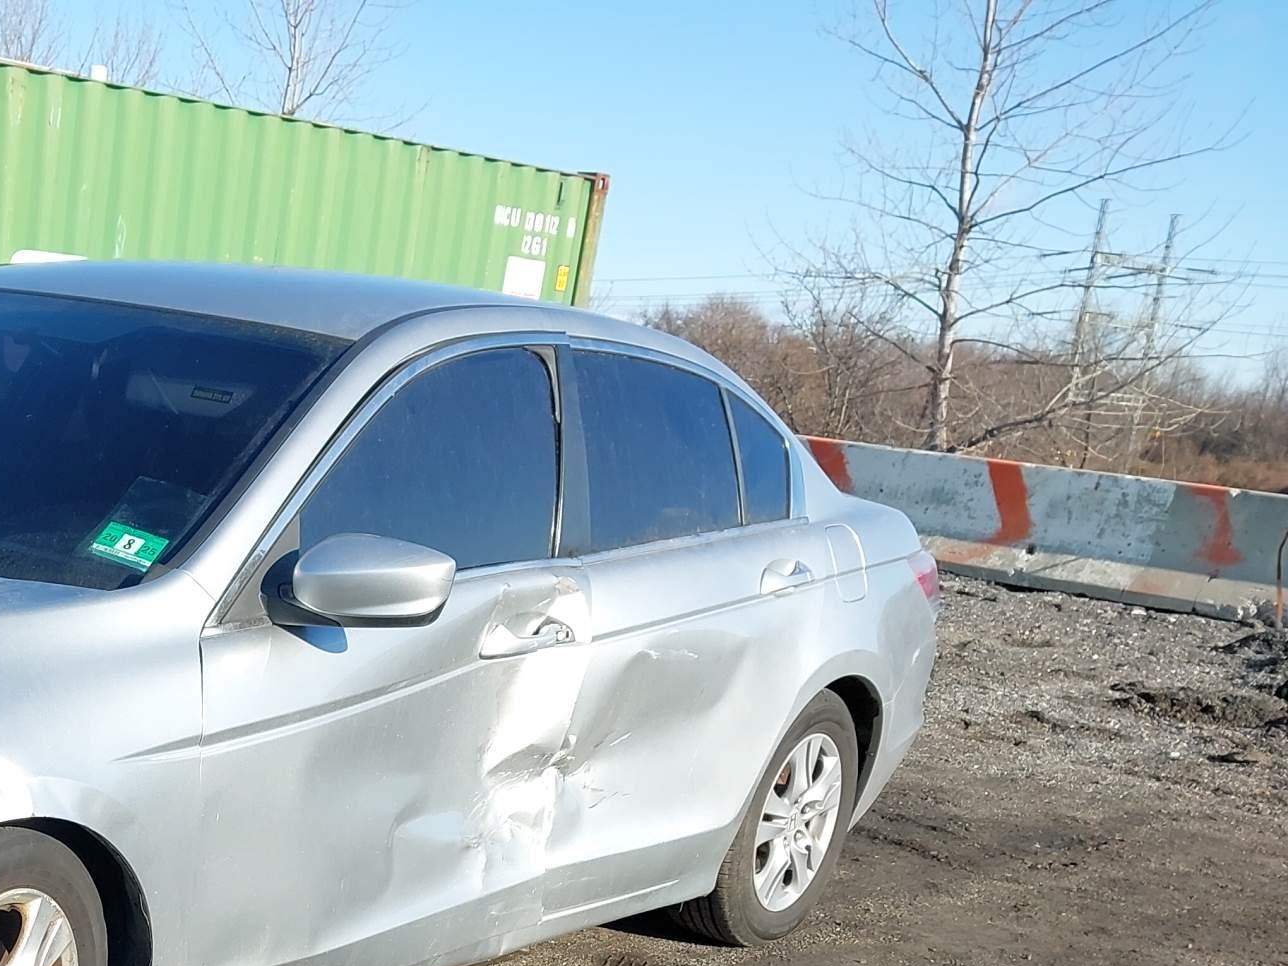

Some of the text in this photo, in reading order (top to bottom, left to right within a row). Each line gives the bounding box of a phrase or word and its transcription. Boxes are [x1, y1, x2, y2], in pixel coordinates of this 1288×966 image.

[102, 532, 118, 543] 20
[123, 538, 135, 550] 8
[141, 545, 156, 556] 25
